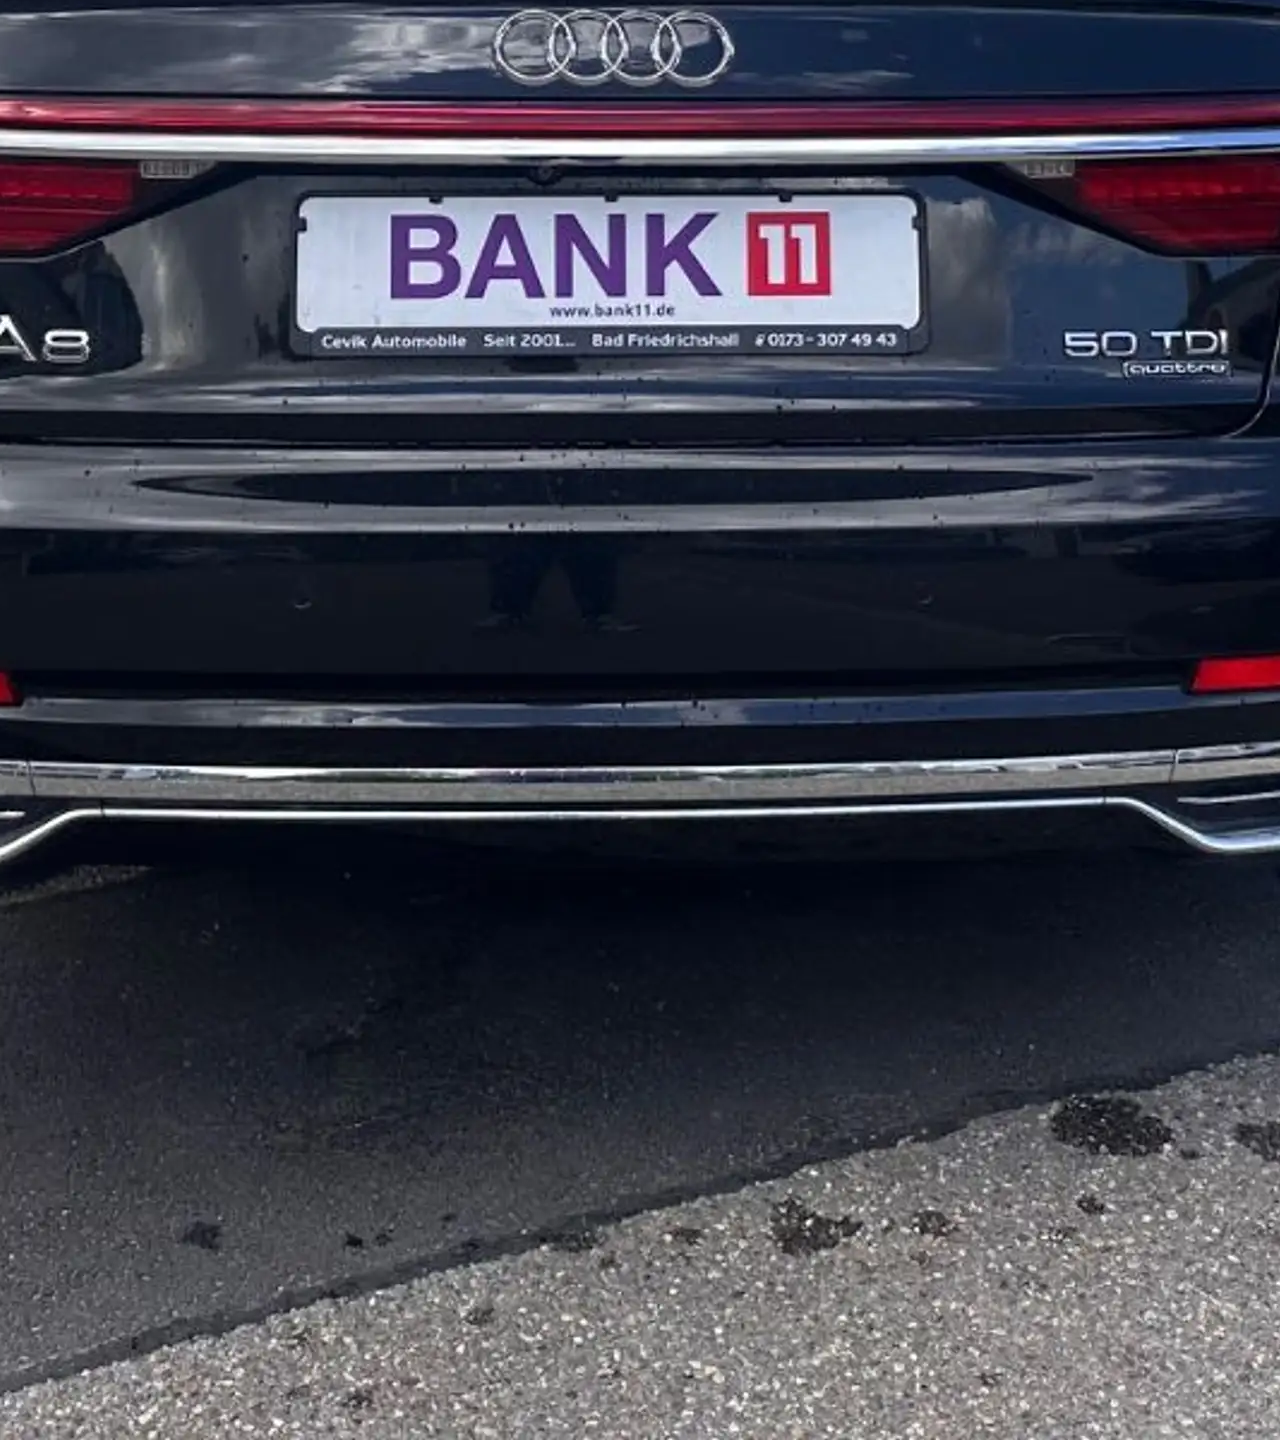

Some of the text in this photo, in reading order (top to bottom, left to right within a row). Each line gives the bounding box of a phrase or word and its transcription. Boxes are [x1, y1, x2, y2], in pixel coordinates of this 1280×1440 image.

[390, 213, 819, 299] BANK 11
[549, 303, 676, 318] www.bank11.de
[320, 333, 368, 349] Cevik
[371, 333, 467, 349] Automobile
[483, 333, 516, 348] Seit
[591, 333, 623, 347] Bad
[628, 332, 739, 347] Friedrichshall
[851, 333, 872, 347] 49
[876, 333, 897, 347] 43
[1063, 329, 1229, 357] 50 TDI
[1128, 361, 1226, 375] quattro
